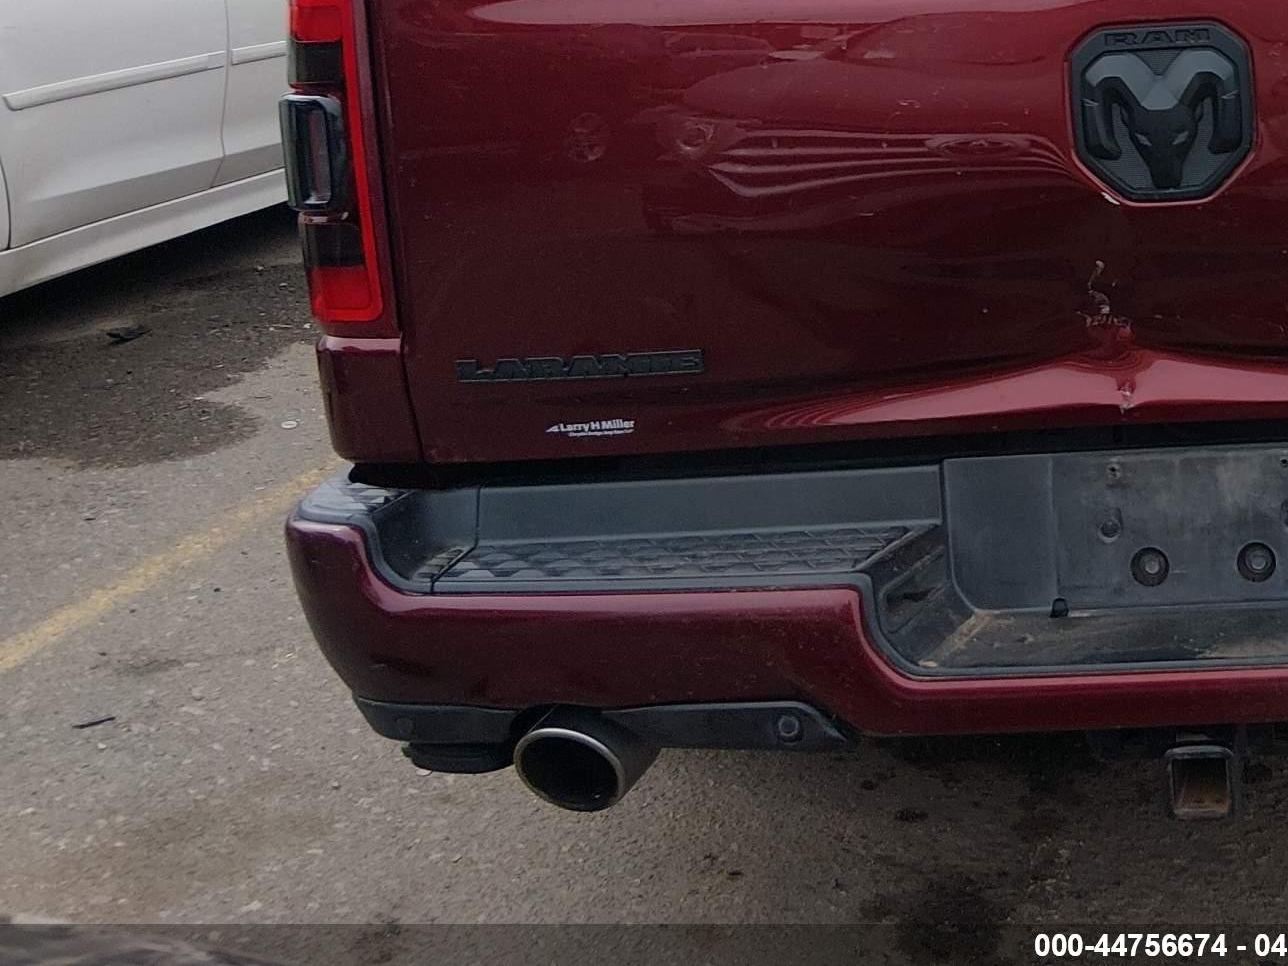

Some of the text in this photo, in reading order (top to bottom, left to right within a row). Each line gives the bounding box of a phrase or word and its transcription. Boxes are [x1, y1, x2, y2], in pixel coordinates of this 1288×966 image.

[1104, 28, 1210, 46] RAM
[454, 348, 704, 383] LARAMIE
[559, 419, 635, 432] Larry H Miller
